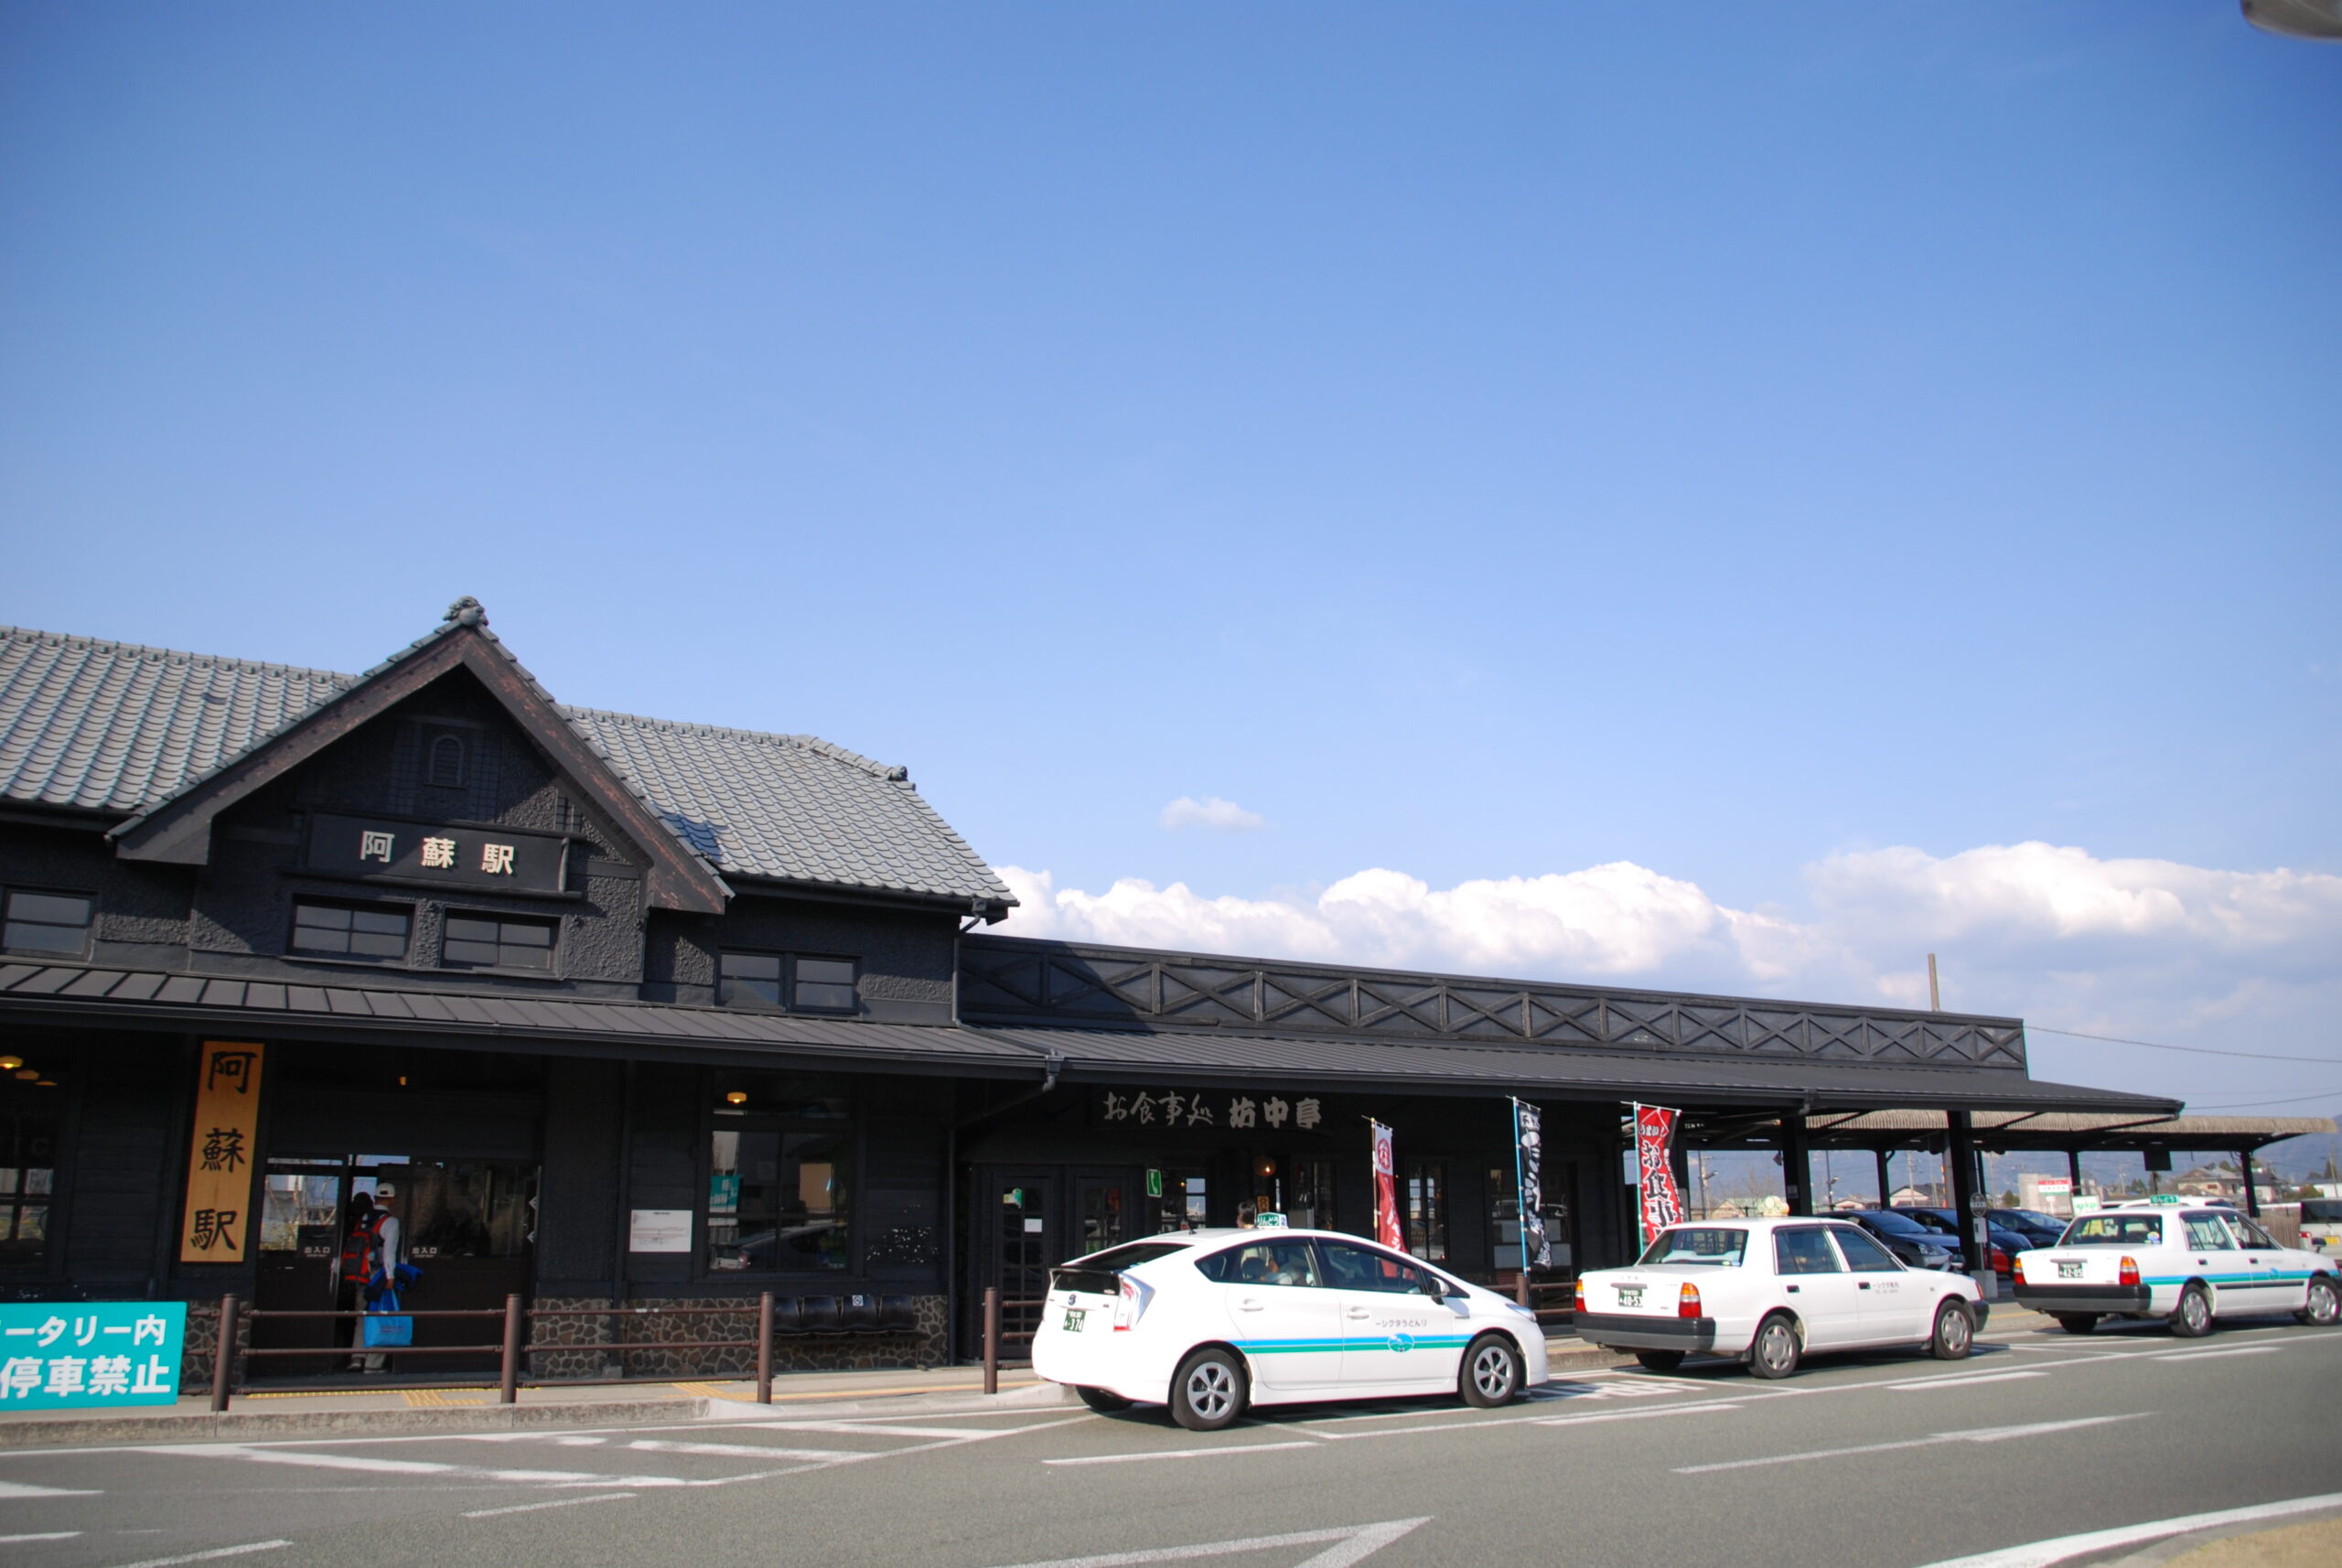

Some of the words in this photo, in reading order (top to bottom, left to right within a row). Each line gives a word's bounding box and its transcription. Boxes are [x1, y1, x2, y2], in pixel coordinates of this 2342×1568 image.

[360, 830, 516, 875] 阿蘇駅
[1103, 1090, 1214, 1127] お食事処
[190, 1050, 258, 1251] 阿蘇駅
[1641, 1140, 1678, 1238] お食事
[0, 1354, 171, 1399] 停車禁止
